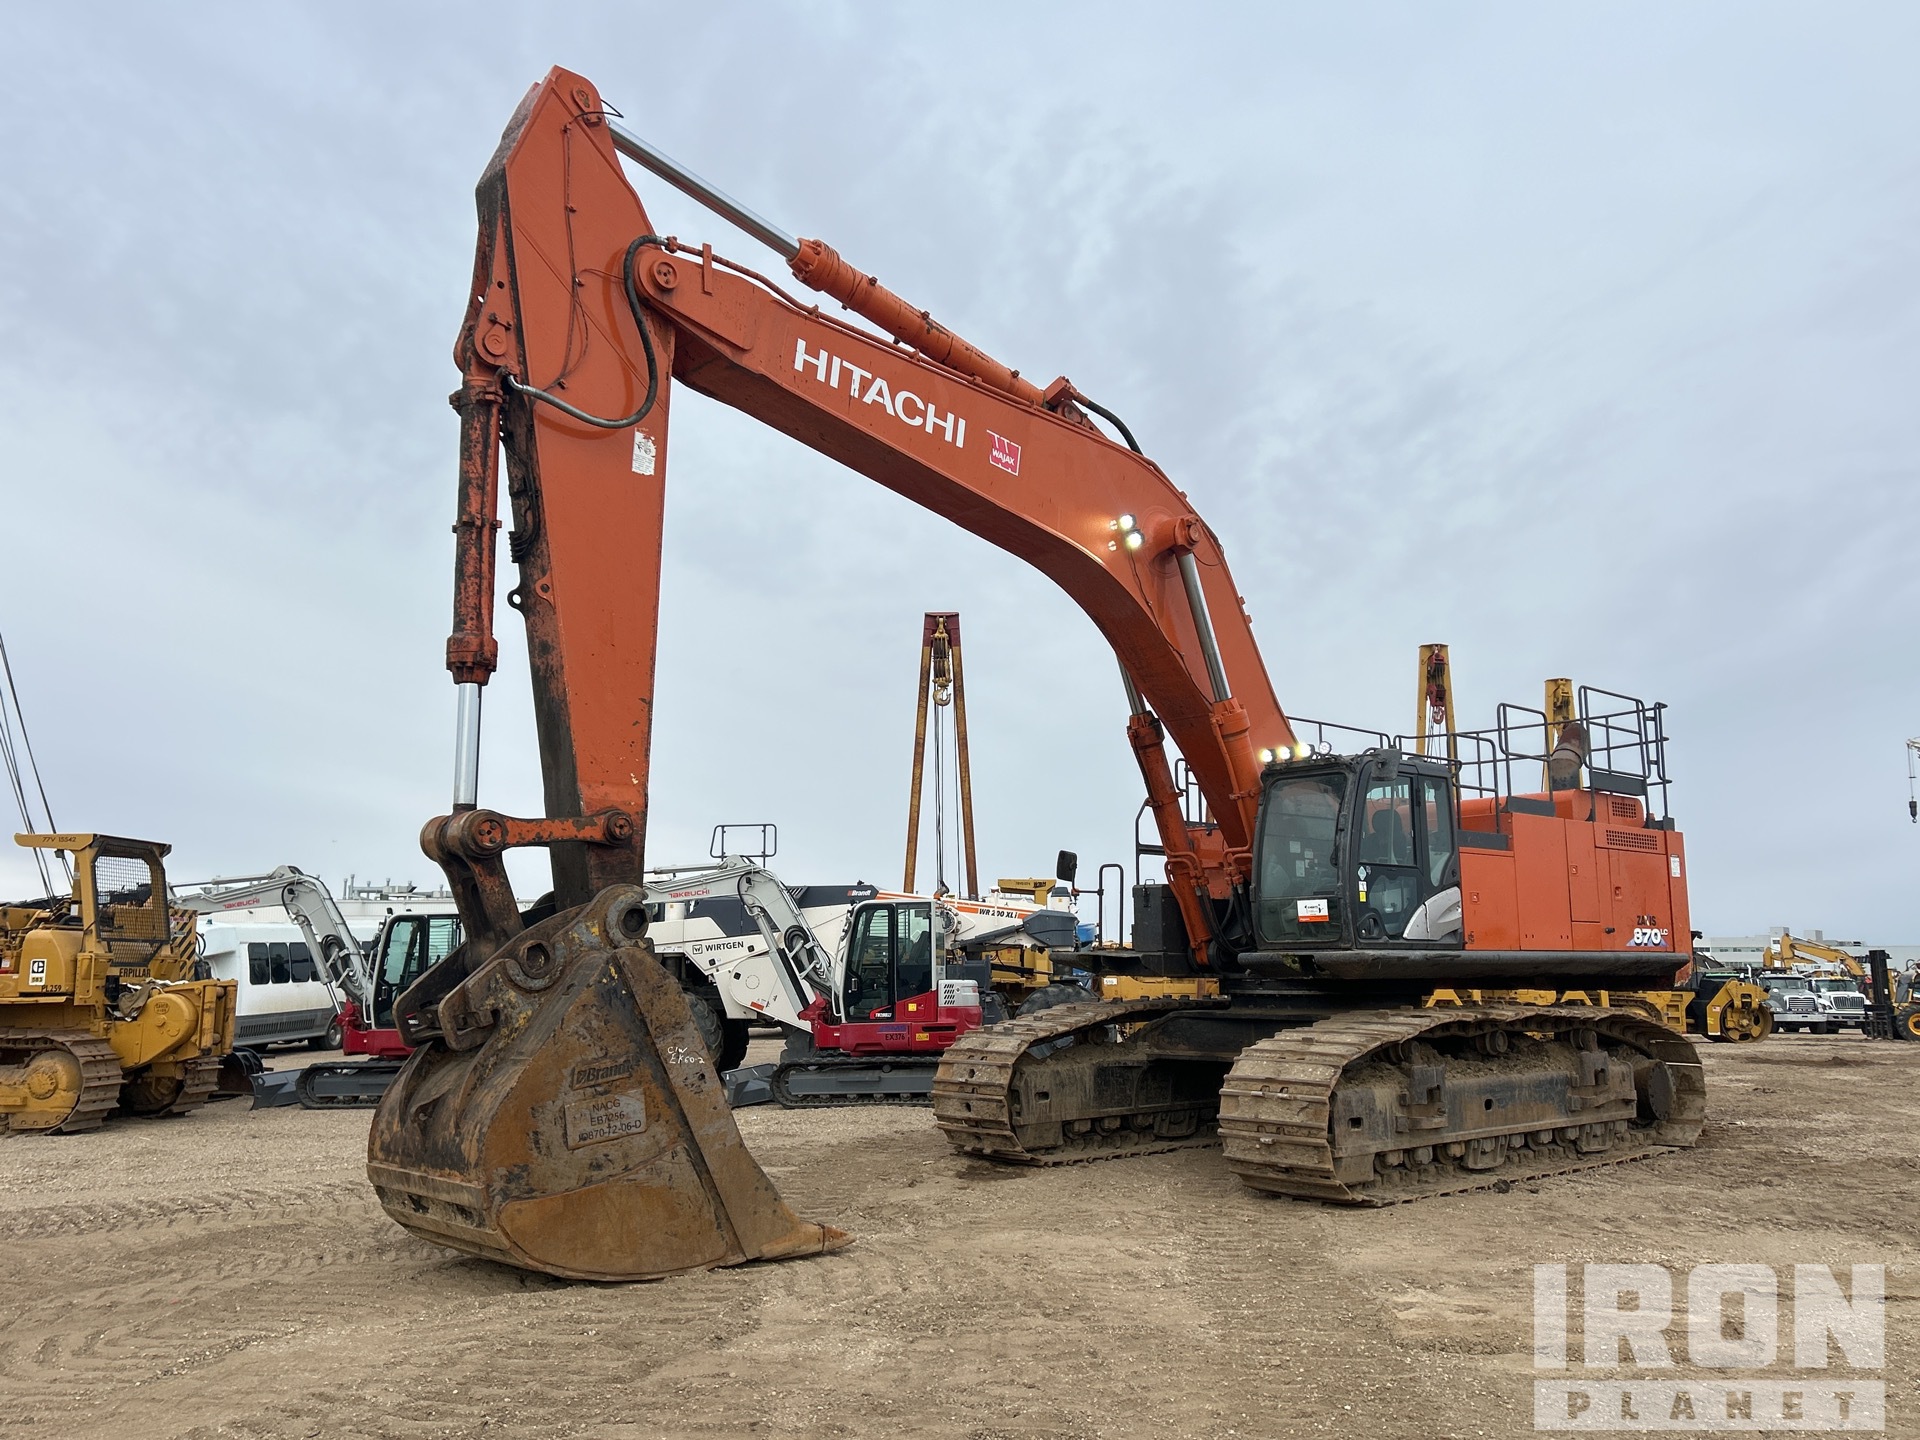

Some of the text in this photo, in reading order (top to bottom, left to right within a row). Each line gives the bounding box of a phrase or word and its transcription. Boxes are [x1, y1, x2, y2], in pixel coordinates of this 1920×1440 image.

[794, 338, 966, 448] HITACHI
[992, 448, 1015, 466] WAJAX
[668, 889, 710, 899] TAKEUCHI
[222, 897, 260, 910] TAKEUCHI
[979, 908, 991, 916] WR
[1633, 927, 1662, 947] 870
[705, 941, 744, 953] WIRTGEN
[120, 968, 151, 978] ERPILLAR
[41, 984, 62, 993] PL259
[885, 1033, 906, 1041] EX376
[592, 1099, 621, 1112] NACG
[590, 1111, 625, 1126] EB7256
